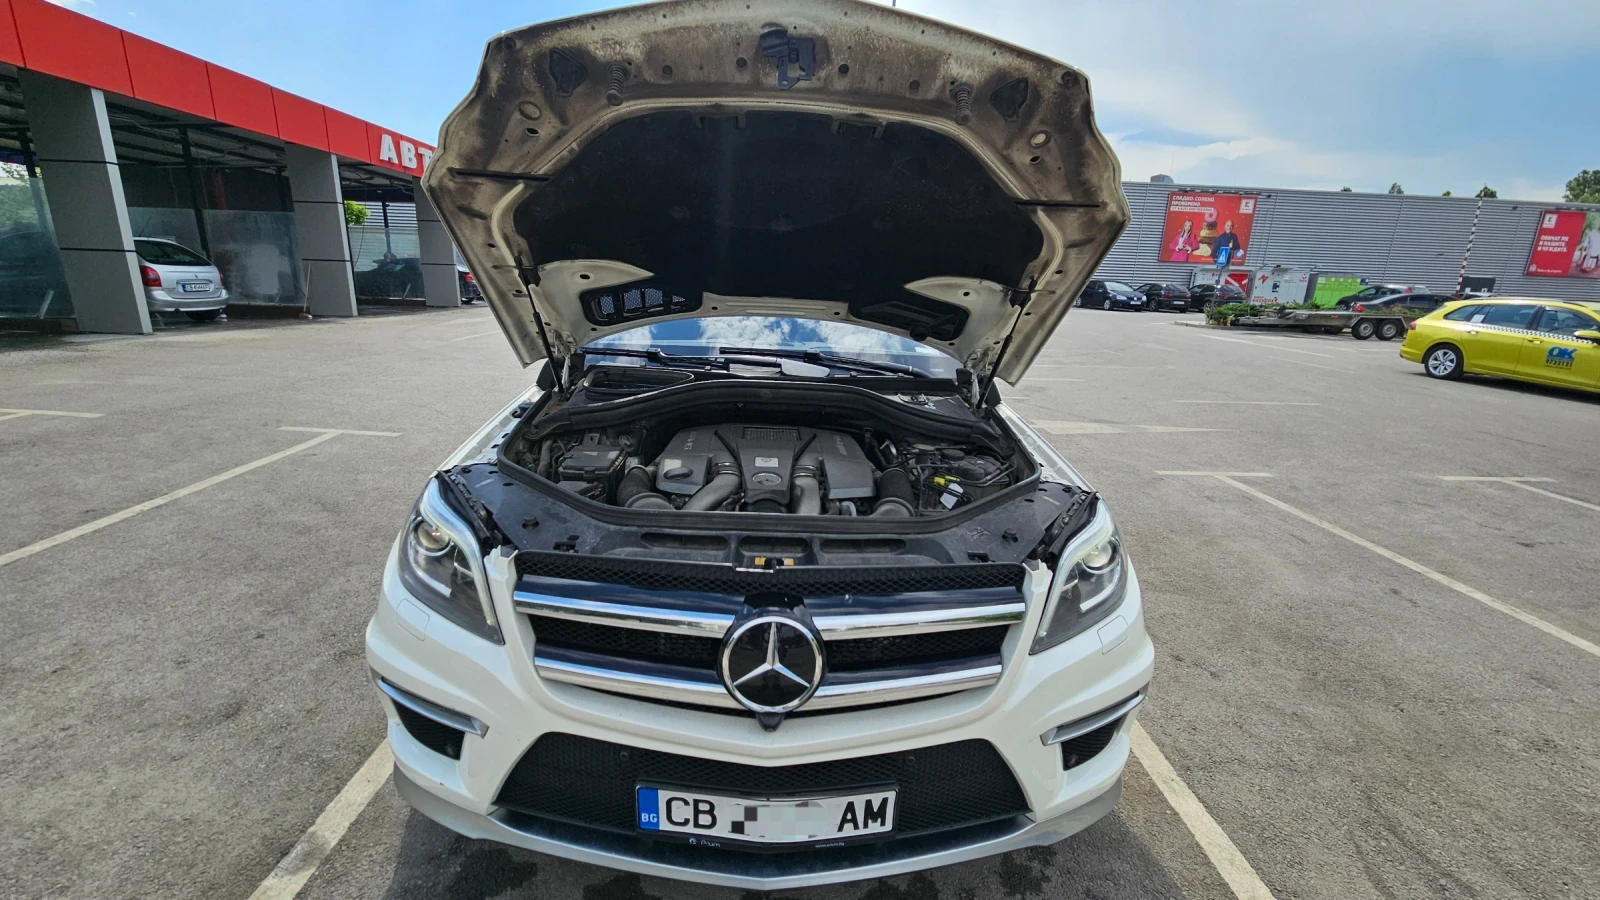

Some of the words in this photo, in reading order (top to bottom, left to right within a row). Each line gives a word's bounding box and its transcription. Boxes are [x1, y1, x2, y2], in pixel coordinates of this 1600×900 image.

[1548, 346, 1578, 359] OK
[641, 812, 658, 823] BG
[665, 796, 718, 830] CB
[837, 796, 889, 832] AM
